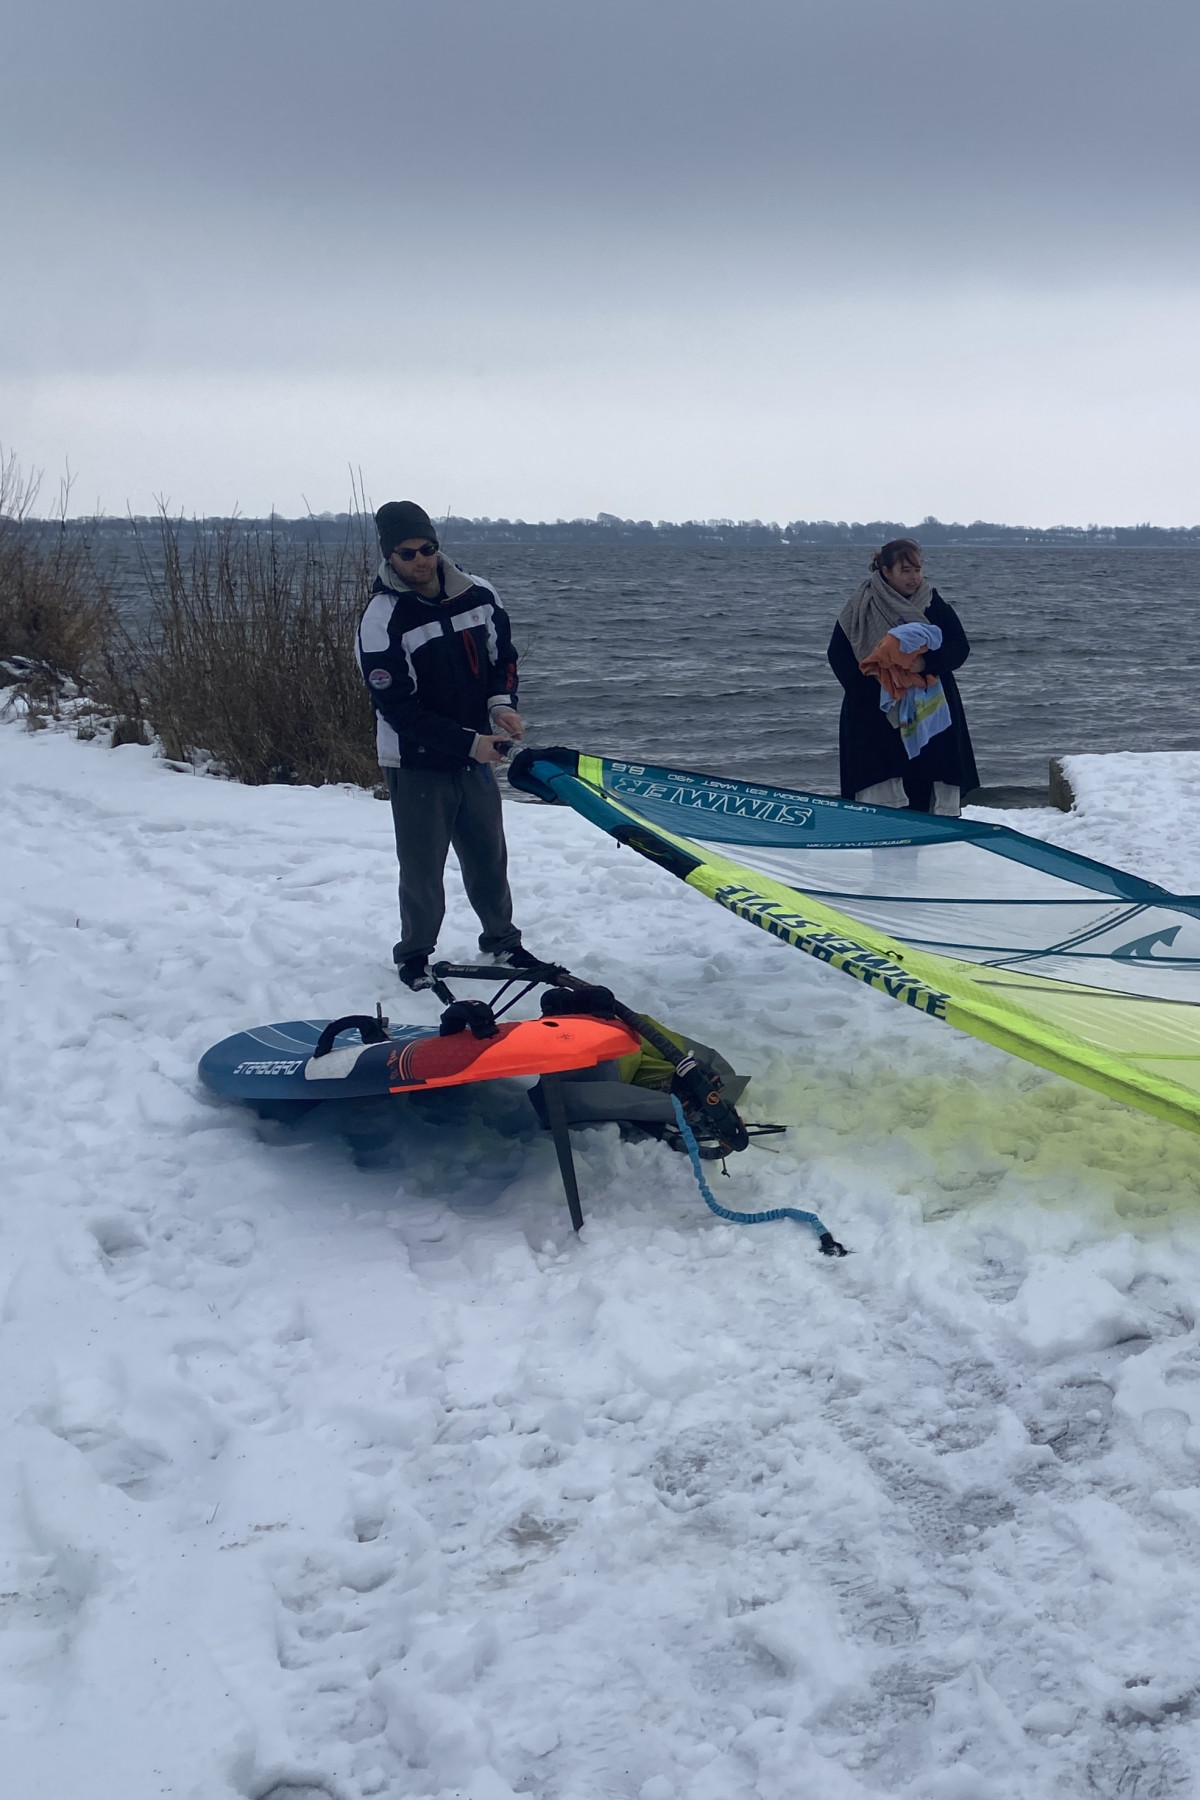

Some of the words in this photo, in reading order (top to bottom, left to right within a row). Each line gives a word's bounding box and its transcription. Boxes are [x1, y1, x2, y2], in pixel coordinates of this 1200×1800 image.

[611, 762, 645, 776] 8.6
[701, 779, 738, 791] MAST
[745, 787, 768, 796] 231
[614, 777, 813, 827] SIMMER
[773, 791, 809, 803] BOOM
[716, 883, 822, 929] STYLE
[841, 959, 947, 1021] STYLE
[232, 1060, 304, 1076] STARBOARD
